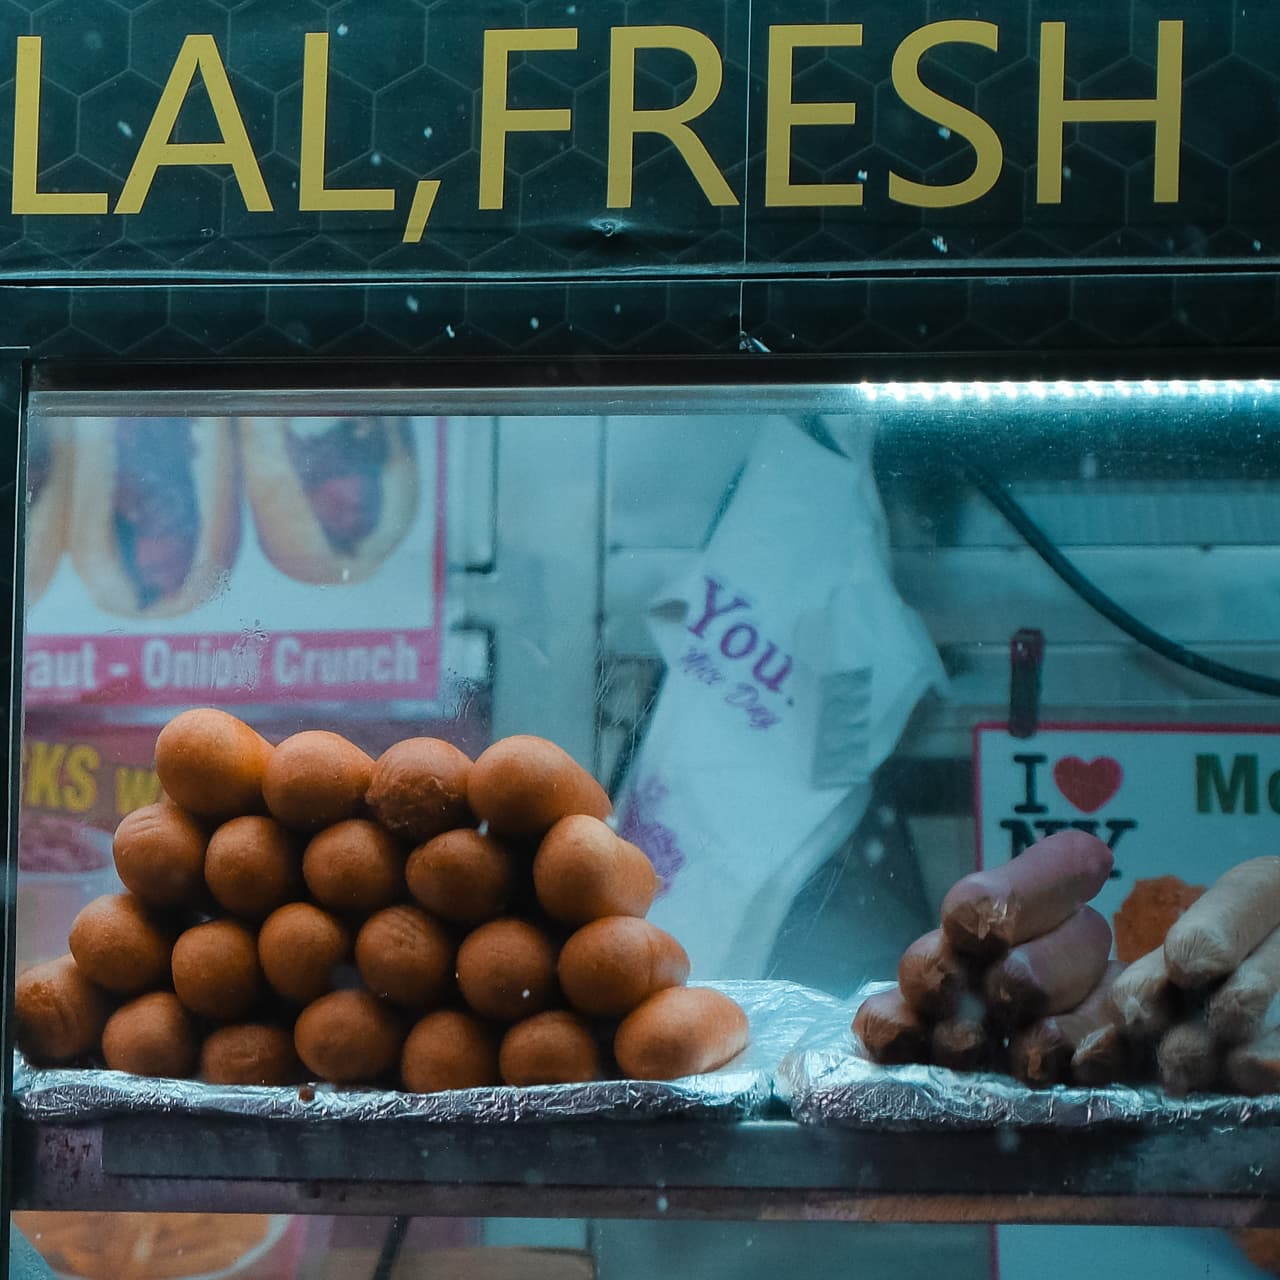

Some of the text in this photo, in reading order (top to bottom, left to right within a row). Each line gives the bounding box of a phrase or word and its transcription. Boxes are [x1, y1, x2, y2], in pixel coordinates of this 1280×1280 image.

[26, 643, 97, 691] aut
[273, 635, 419, 686] Crunch
[686, 576, 793, 692] You
[1013, 753, 1050, 814] I
